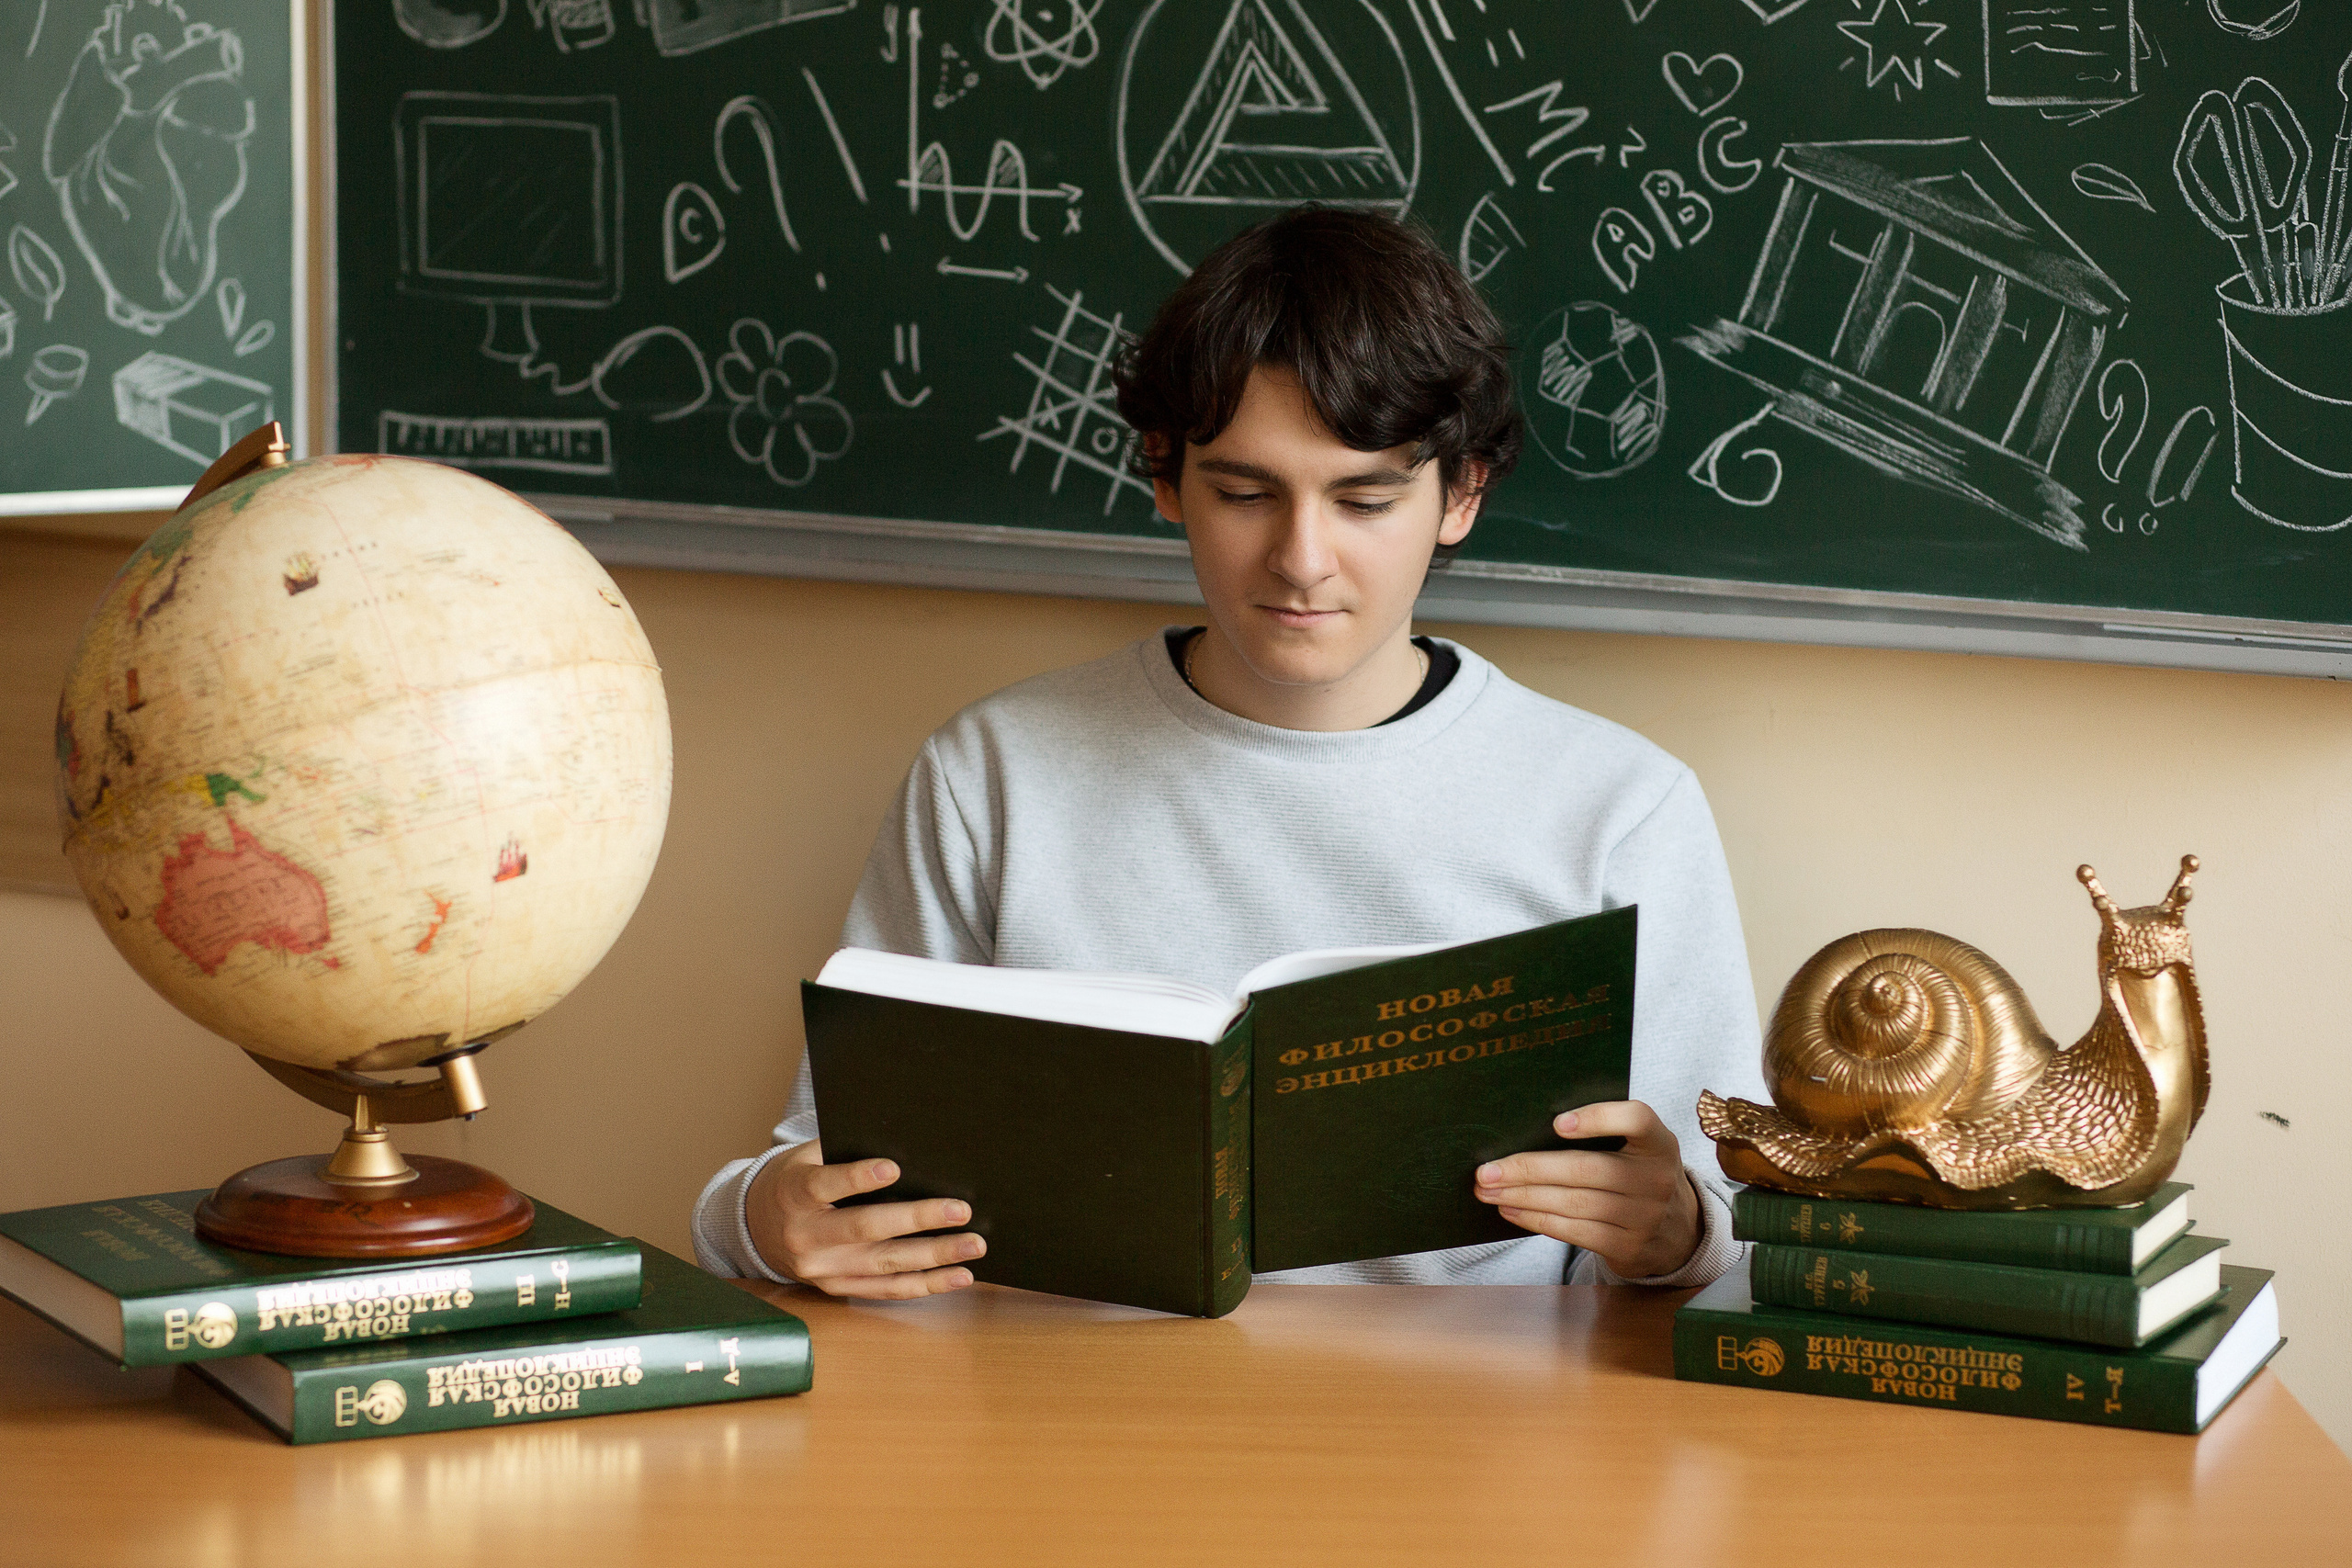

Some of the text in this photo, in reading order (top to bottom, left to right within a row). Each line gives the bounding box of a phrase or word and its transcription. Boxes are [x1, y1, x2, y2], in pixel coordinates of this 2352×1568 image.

[1376, 975, 1515, 1022] НОВАЯ
[1278, 983, 1611, 1067] ФИЛОСОФСКАЯ
[256, 1269, 472, 1312] ЭНЦИКЛОПЕДИЯ
[257, 1289, 474, 1332] ФИЛОСОФСКАЯ
[322, 1314, 411, 1342] НОВАЯ
[427, 1346, 641, 1388] ЭНЦИКЛОПЕДИЯ
[1806, 1335, 2024, 1373] ЭНЦИКЛОПЕДИЯ
[1806, 1353, 2022, 1392] ФИЛОСОФСКАЯ
[428, 1365, 643, 1407] ФИЛОСОФСКАЯ
[493, 1390, 580, 1418] НОВАЯ
[1871, 1377, 1957, 1402] НОВАЯ
[2065, 1372, 2085, 1401] IV
